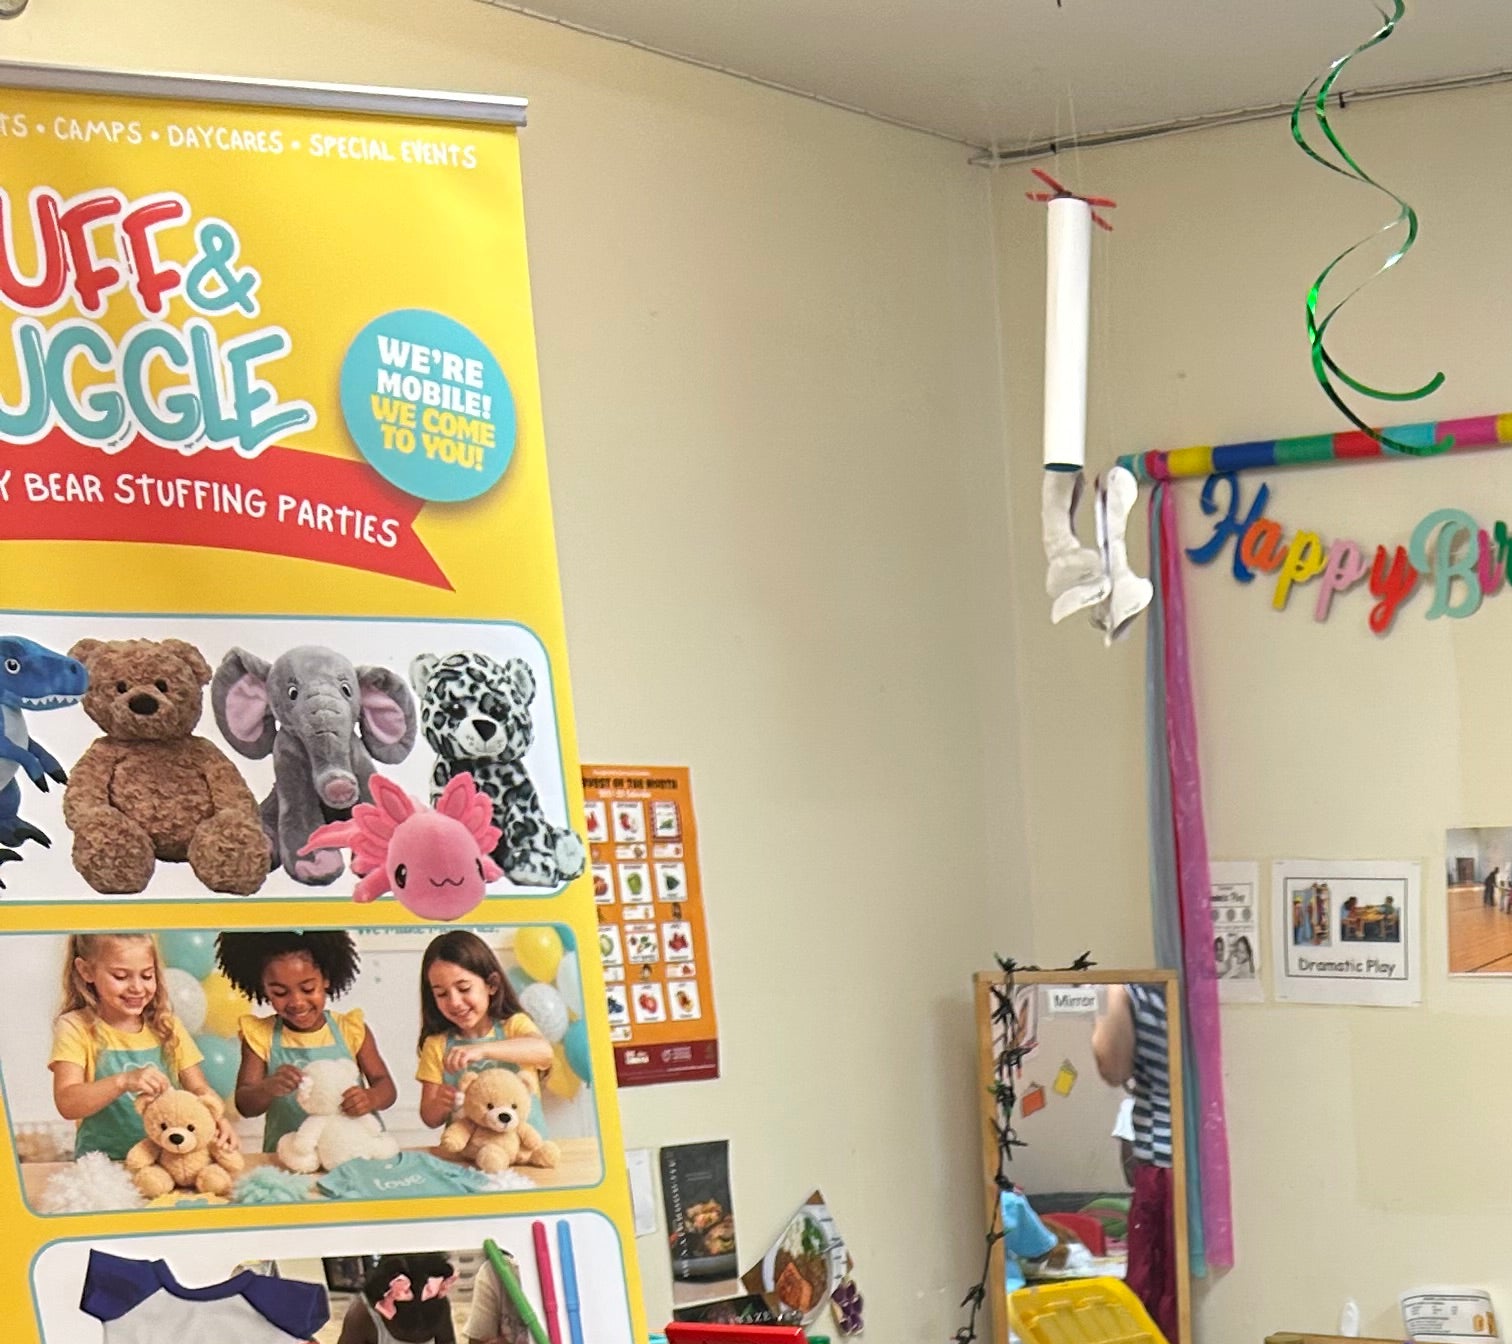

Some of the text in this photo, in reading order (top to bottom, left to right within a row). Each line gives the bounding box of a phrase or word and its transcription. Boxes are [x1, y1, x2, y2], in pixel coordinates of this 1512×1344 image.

[54, 116, 143, 144] CAMPS
[167, 124, 284, 153] DAYCARES
[309, 133, 396, 161] SPECIAL
[400, 140, 478, 169] EVENTS
[377, 334, 484, 389] WE'RE
[377, 368, 492, 420] MOBILE!
[371, 394, 496, 448] WE COME
[381, 423, 485, 472] TO YOU!
[24, 473, 104, 502] BEAR
[114, 474, 267, 518] STUFFING
[278, 498, 399, 548] PARTIES
[1185, 471, 1419, 634] Happy
[1298, 957, 1396, 977] Dramatic Play
[373, 1174, 427, 1191] love
